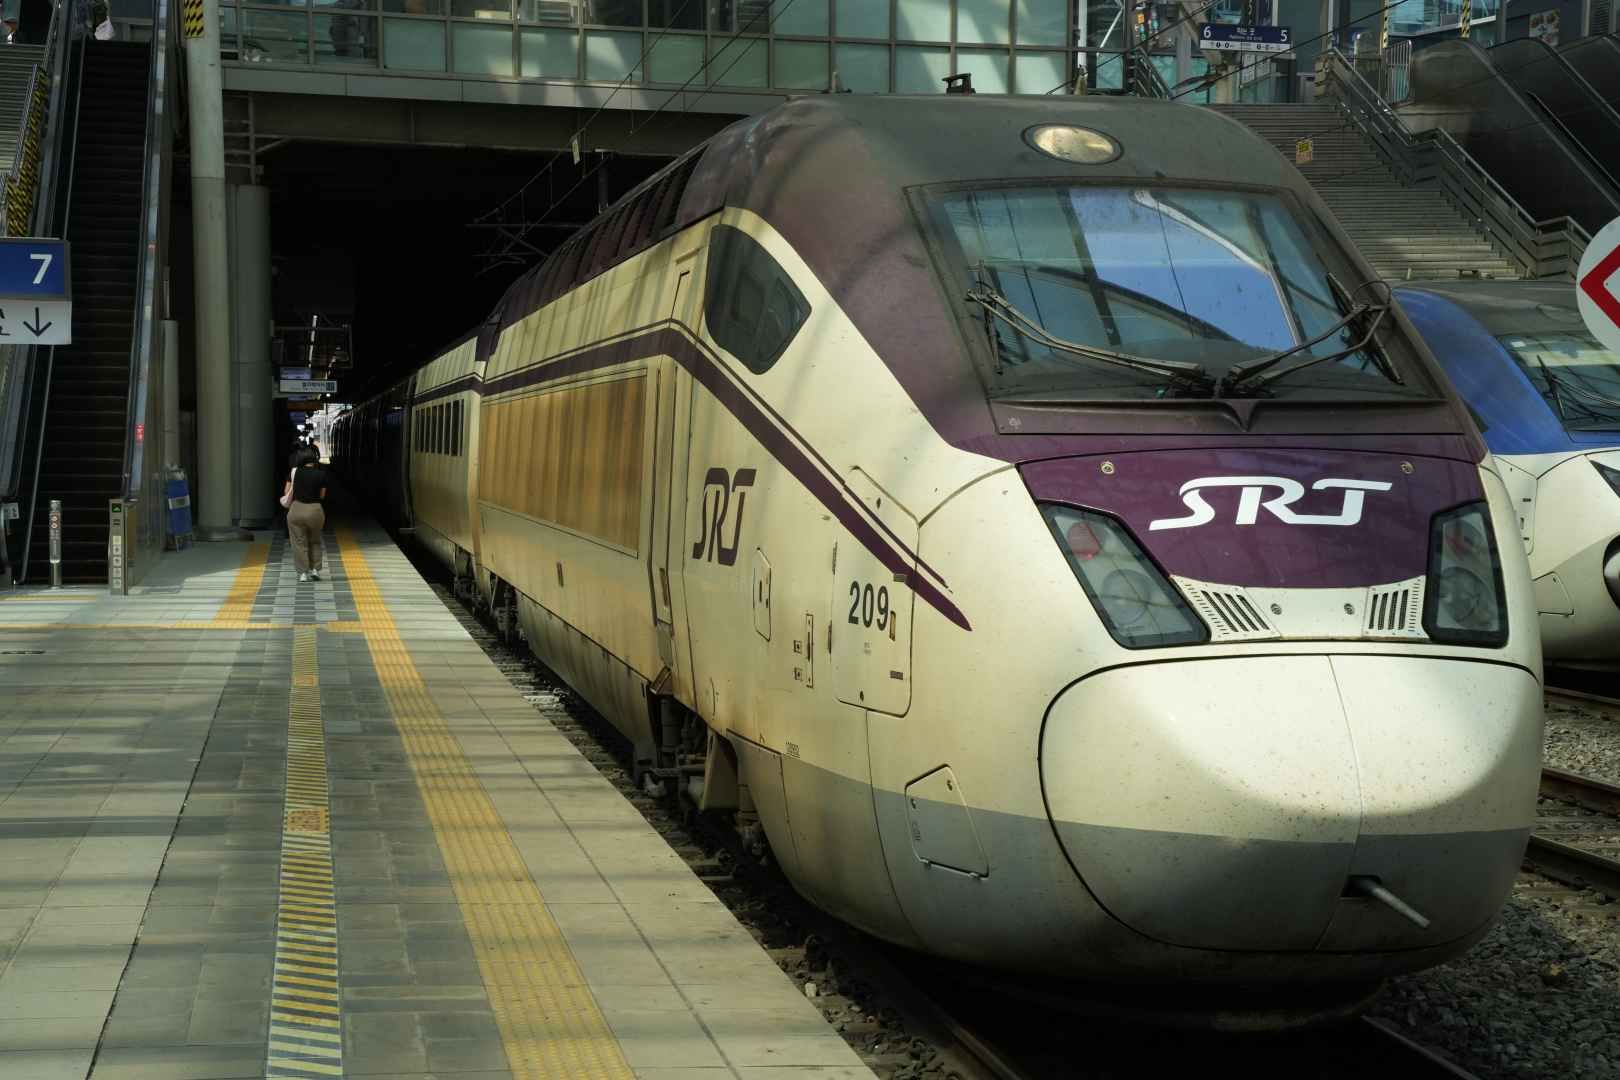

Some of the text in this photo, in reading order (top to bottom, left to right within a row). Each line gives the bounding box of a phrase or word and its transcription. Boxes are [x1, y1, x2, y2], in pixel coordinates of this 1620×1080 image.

[1203, 26, 1211, 38] 6
[1281, 30, 1288, 42] 5
[30, 253, 53, 285] 7
[692, 467, 757, 567] SRT
[1149, 476, 1393, 531] SRT
[848, 581, 889, 631] 209
